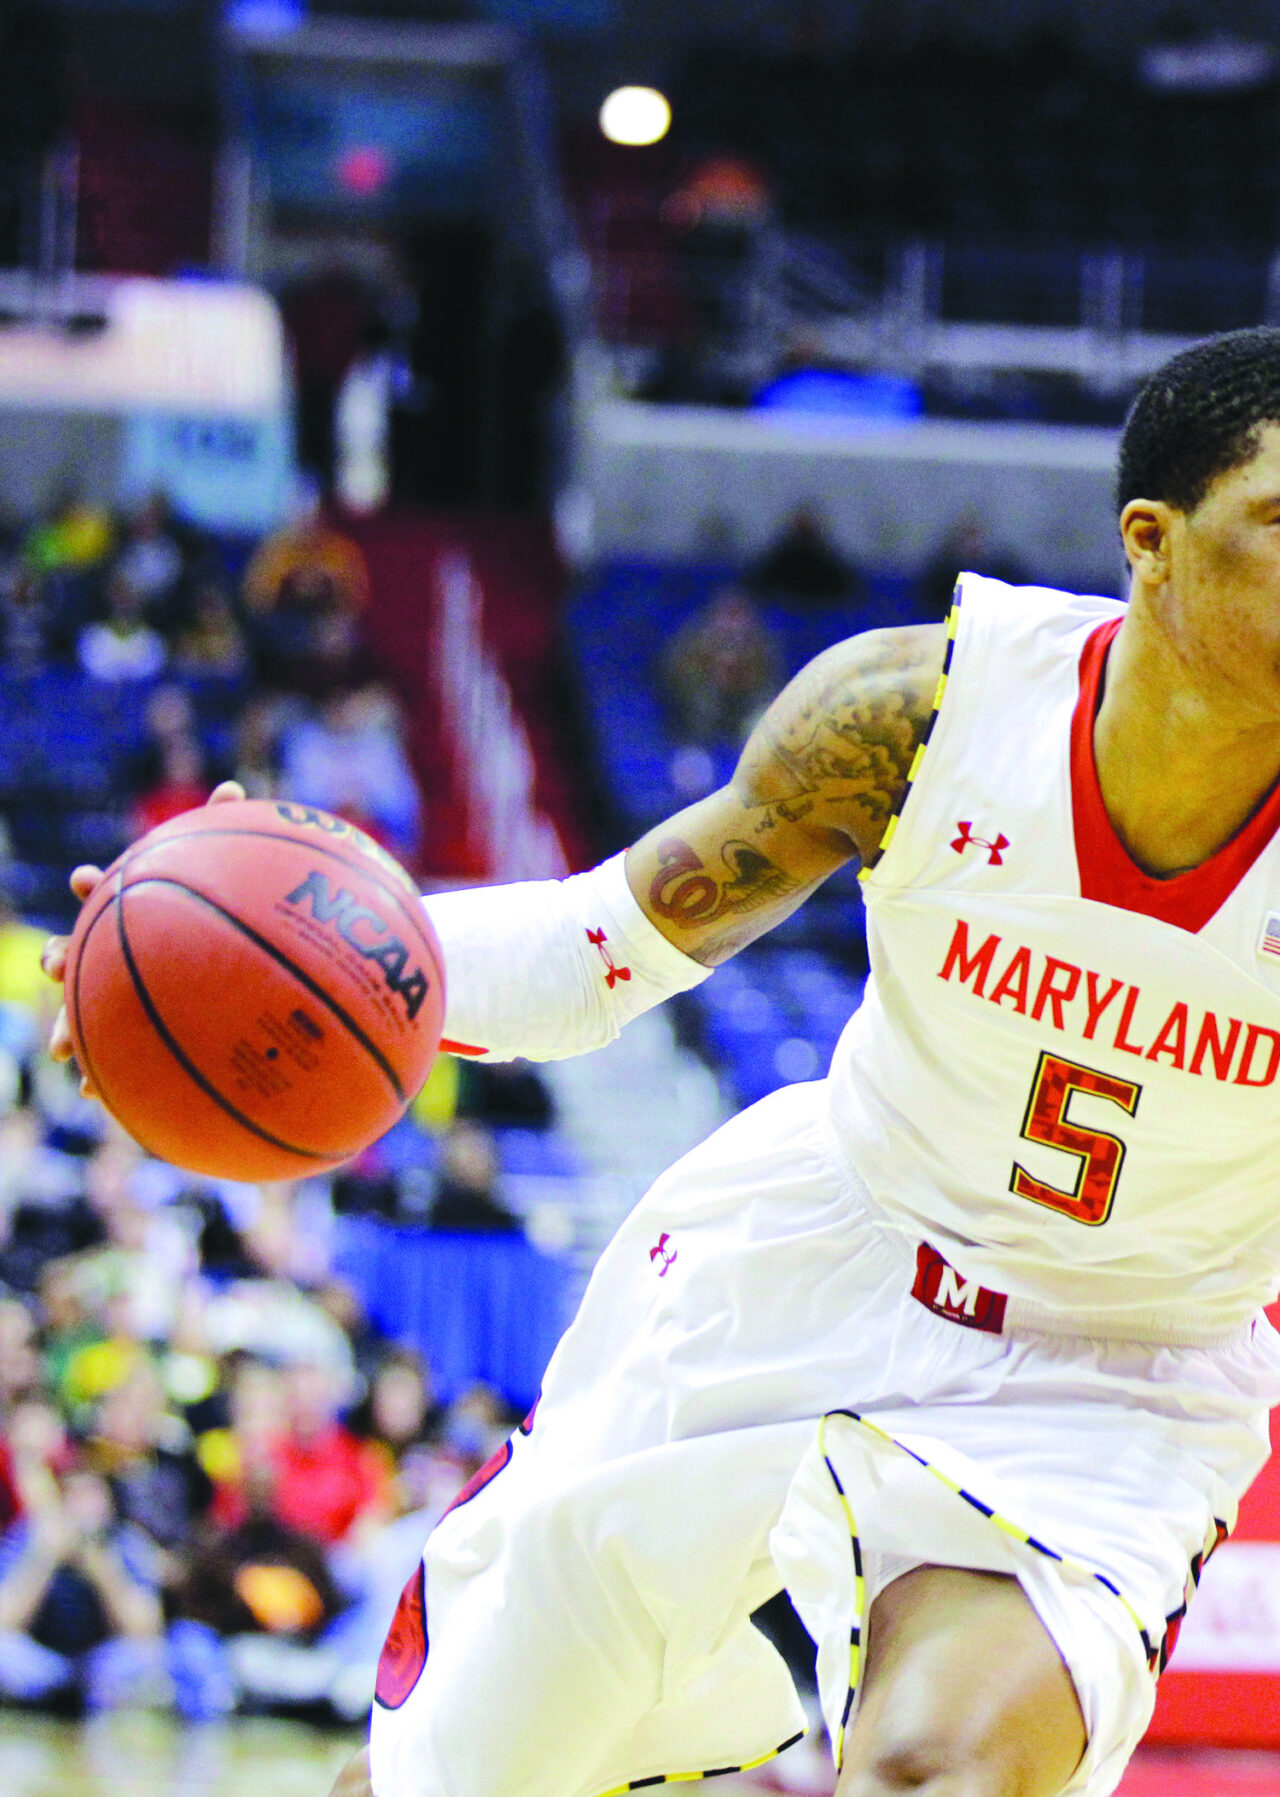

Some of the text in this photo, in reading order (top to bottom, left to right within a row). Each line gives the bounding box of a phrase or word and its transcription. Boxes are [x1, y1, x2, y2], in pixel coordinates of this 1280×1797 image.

[285, 871, 429, 1020] NCAA
[1008, 1050, 1143, 1227] 5
[934, 1264, 980, 1316] M
